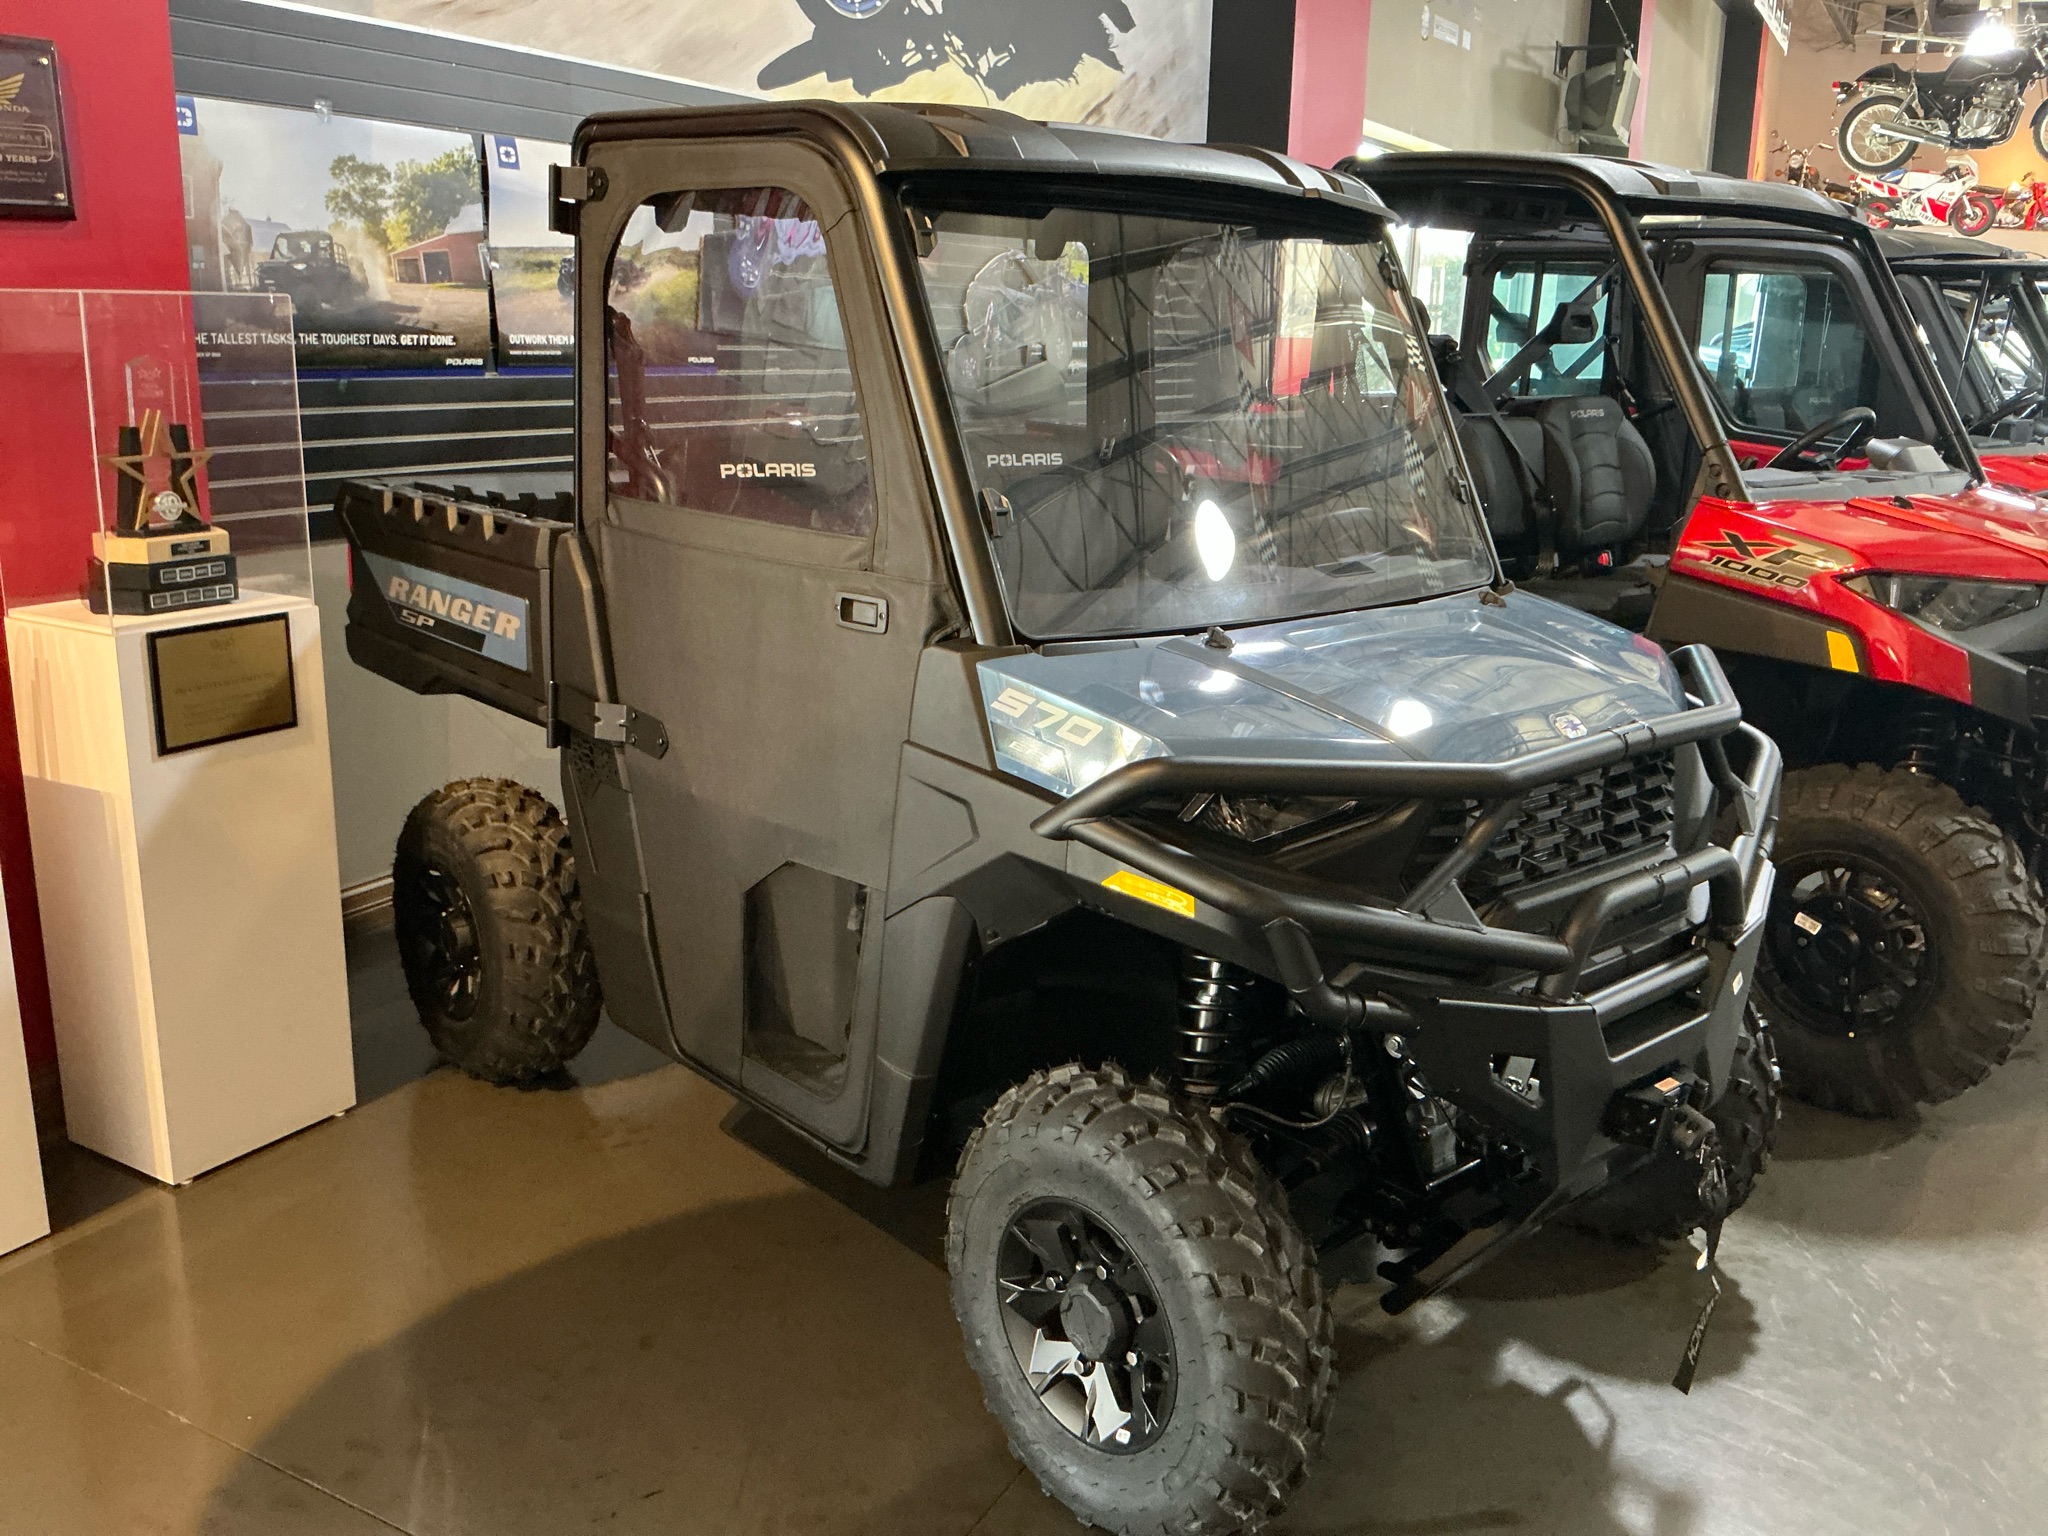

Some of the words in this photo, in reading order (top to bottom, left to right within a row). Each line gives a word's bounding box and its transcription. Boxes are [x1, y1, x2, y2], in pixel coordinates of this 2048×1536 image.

[0, 104, 31, 113] NDA
[5, 154, 37, 164] YEARS
[210, 332, 258, 345] TALLEST
[298, 332, 319, 345] THE
[320, 332, 372, 345] TOUGHEST
[372, 333, 400, 346] DAYS.
[400, 334, 419, 346] GET
[419, 334, 429, 346] IT
[429, 335, 456, 347] DONE.
[509, 334, 547, 345] OUTWORK
[547, 334, 569, 345] THEM
[445, 358, 484, 366] POLARIS
[1570, 408, 1605, 419] POLARIS
[986, 452, 1063, 468] POLARIS
[719, 462, 817, 479] POLARIS
[1688, 528, 1840, 572] XP
[1709, 555, 1811, 590] 1000
[388, 576, 521, 641] RANGER
[400, 608, 436, 628] SP
[990, 687, 1103, 747] 570
